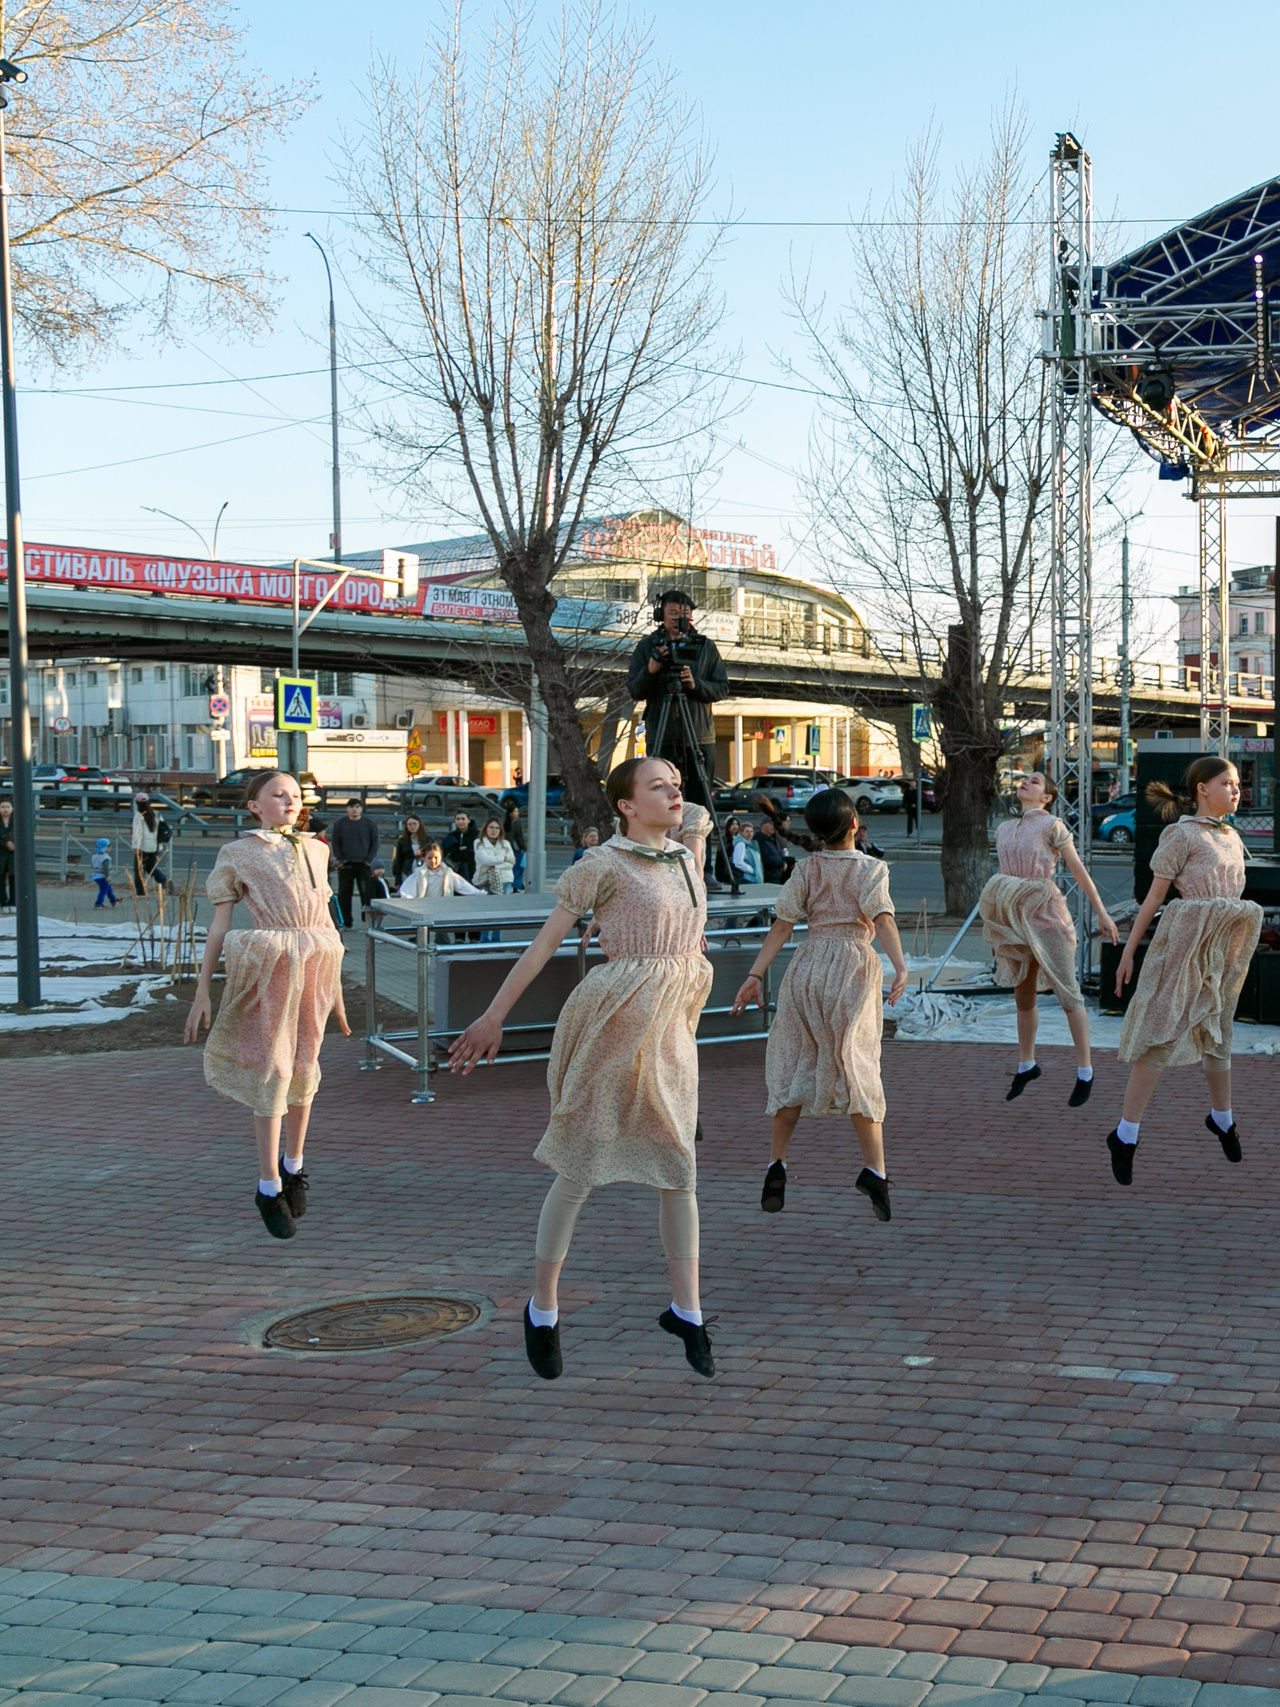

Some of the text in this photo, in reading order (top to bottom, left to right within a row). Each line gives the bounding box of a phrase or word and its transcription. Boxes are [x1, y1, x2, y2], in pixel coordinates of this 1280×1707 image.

[0, 547, 135, 585] СТИВАЛЬ
[143, 561, 254, 596] «МУЗЫКА
[432, 588, 445, 601] 31
[448, 589, 471, 604] МАЯ
[410, 758, 420, 768] 50
